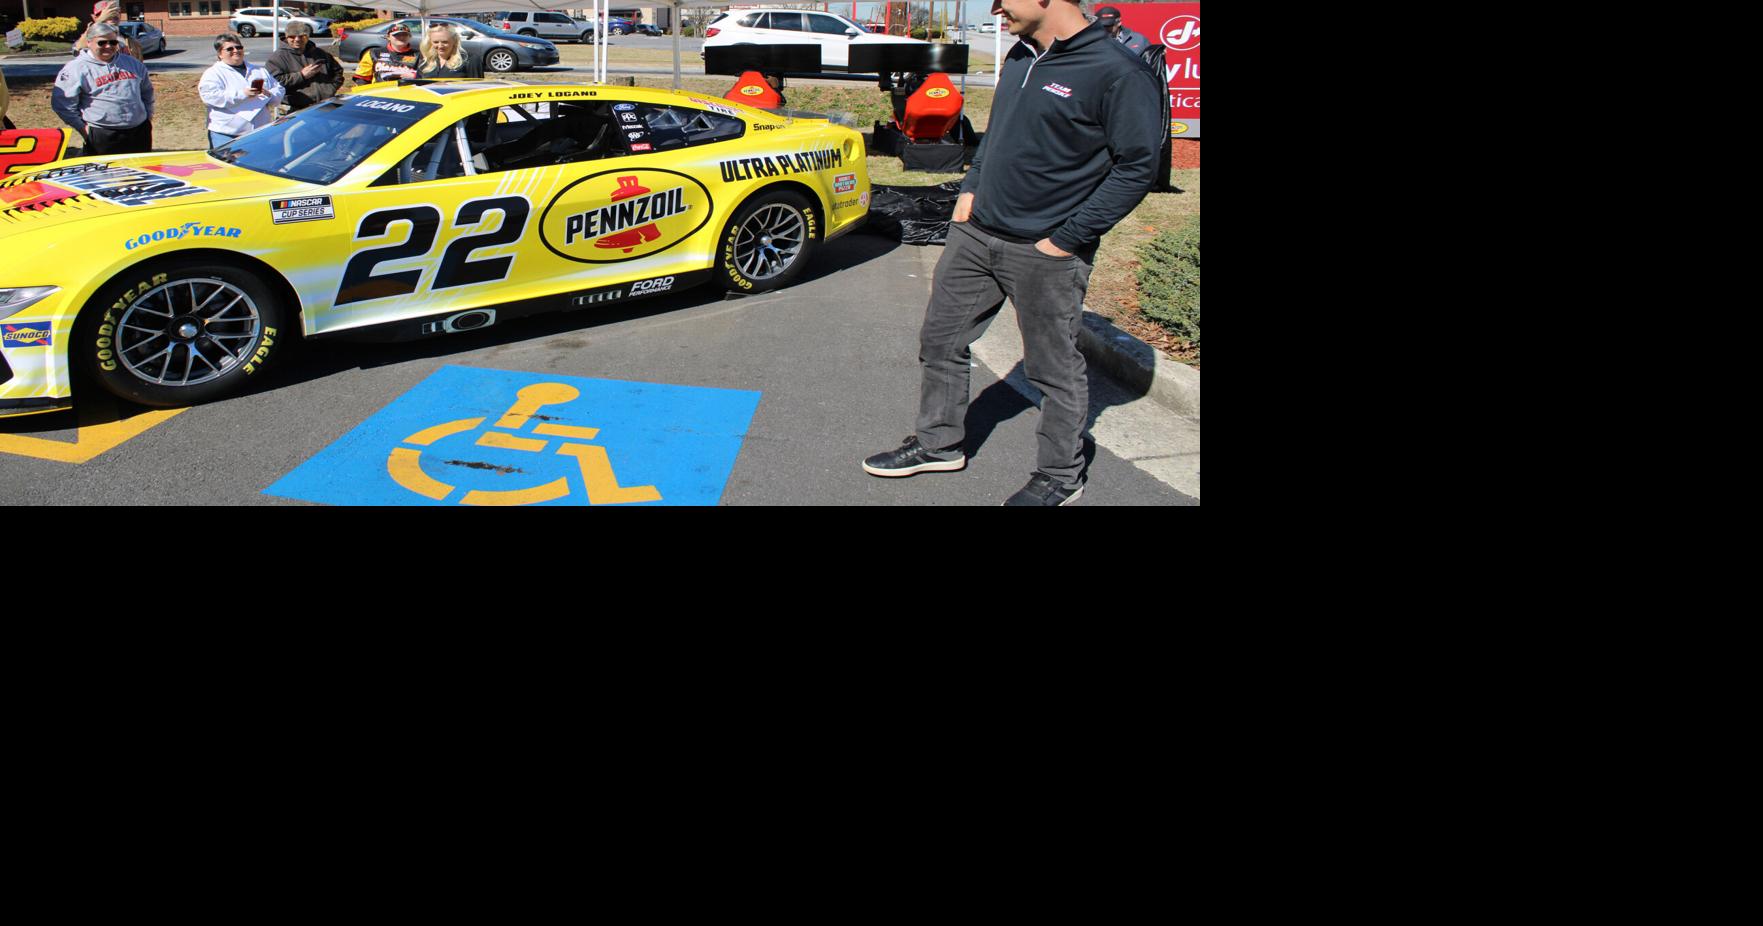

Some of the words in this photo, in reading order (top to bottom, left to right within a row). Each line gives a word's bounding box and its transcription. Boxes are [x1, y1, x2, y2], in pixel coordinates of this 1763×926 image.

[355, 99, 415, 113] LOGANO
[548, 90, 597, 98] LOGANO
[719, 156, 780, 183] ULTRA
[775, 148, 842, 176] PLATINUM
[281, 210, 298, 218] CUP
[298, 207, 325, 216] SERIES
[290, 197, 323, 207] NASCAR
[565, 186, 687, 245] PENNZOIL
[125, 223, 242, 250] GOODYEAR
[802, 207, 817, 239] EAGLE
[334, 195, 531, 307] 22
[724, 225, 753, 290] GOODYEAR
[628, 284, 672, 297] PERFORMANCE
[630, 276, 675, 291] FORD
[6, 330, 50, 340] SUNOCO
[96, 272, 169, 371] GOODYEAR
[242, 325, 278, 376] EAGLE
